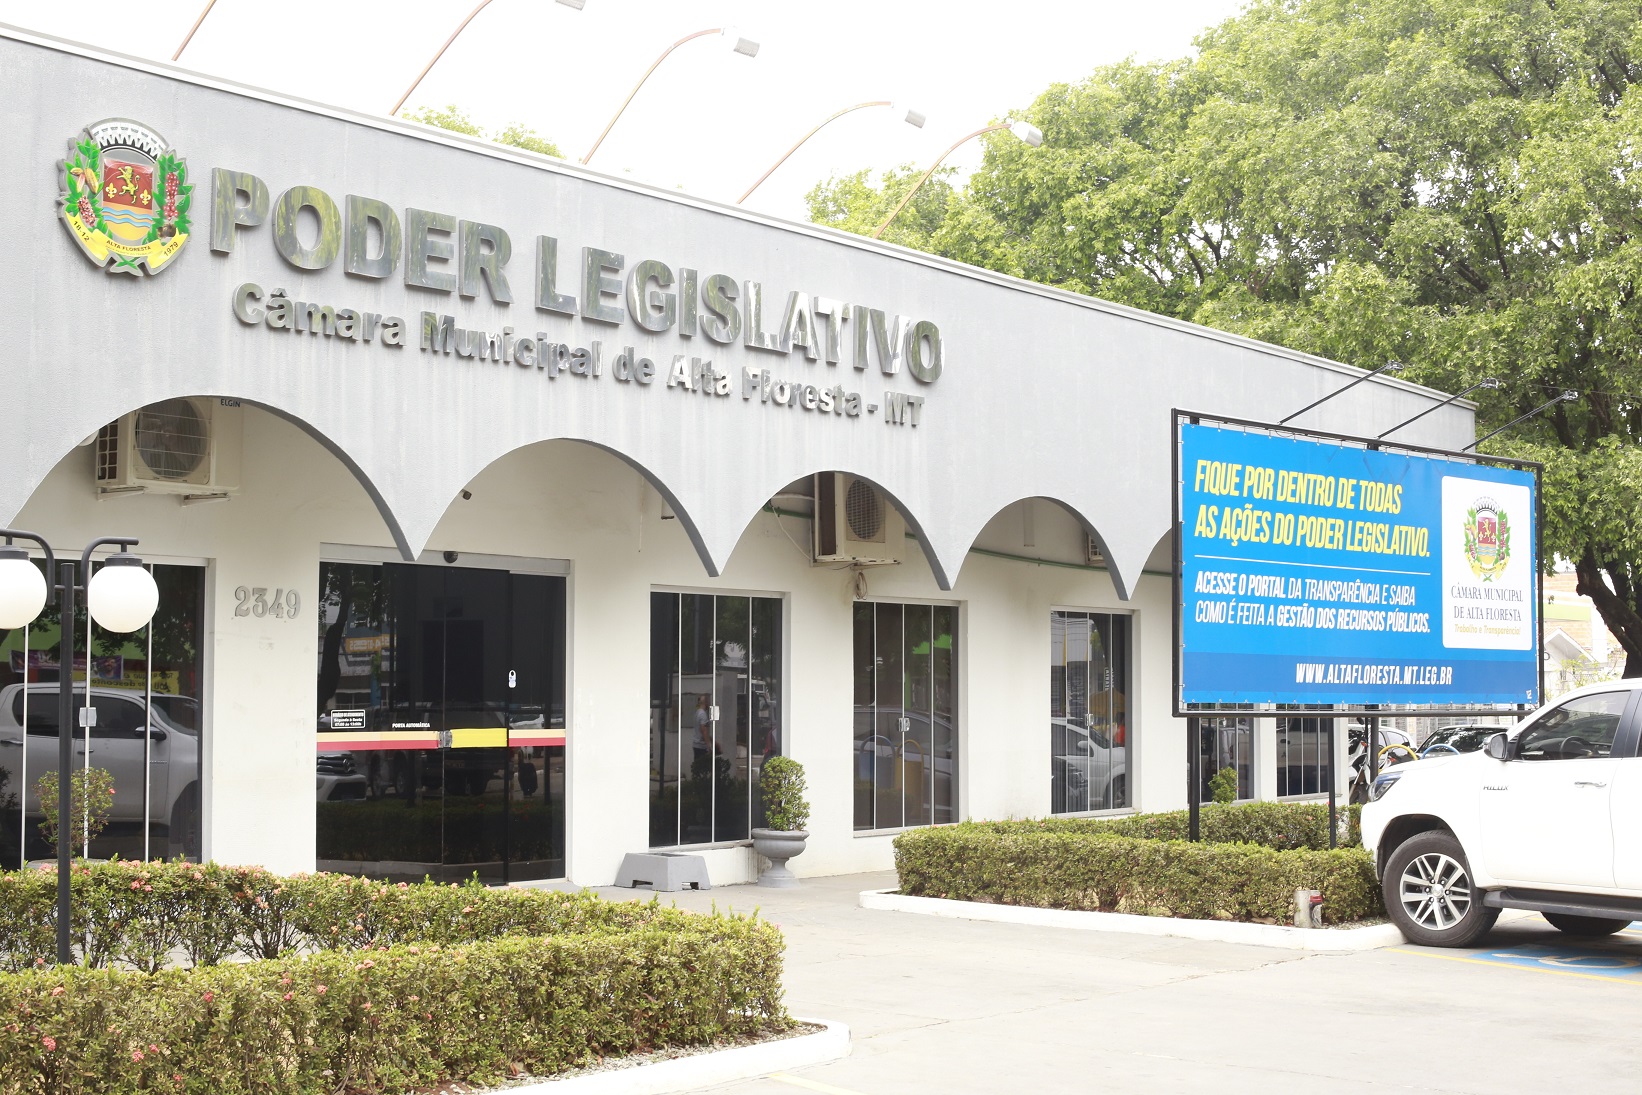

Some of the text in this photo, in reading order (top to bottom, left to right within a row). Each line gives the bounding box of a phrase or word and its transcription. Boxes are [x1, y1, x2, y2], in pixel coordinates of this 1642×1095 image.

[73, 220, 90, 242] 18-12
[106, 239, 121, 250] ALTA
[163, 241, 179, 256] 1979
[210, 167, 945, 382] PODER LEGISLATIVO
[232, 282, 407, 347] Câmara
[420, 311, 602, 378] Municipal
[612, 346, 655, 384] de
[667, 354, 733, 396] Alta
[742, 366, 862, 417] Floresta
[884, 391, 925, 426] MT
[220, 398, 241, 408] ELGIN
[1194, 459, 1403, 514] FIQUE POR DENTRO DE TODAS
[1194, 503, 1430, 557] AS AÇÕES DO PODER LEGISLATIVO.
[1195, 571, 1416, 606] ACESSE O PORTAL DA TRANSPARÊNCIA E SAIBA
[1451, 582, 1523, 602] CÂMARA MUNICIPAL
[235, 585, 301, 619] 2349
[1454, 605, 1522, 621] DE ALTA FLORESTA
[1195, 598, 1430, 633] COMO É FEITA A GESTÃO DOS RECURSOS PÚBLICOS.
[1454, 624, 1477, 634] Trabalho
[1295, 663, 1453, 685] WWW.ALTAFLORESTA.MT.LEG.BR
